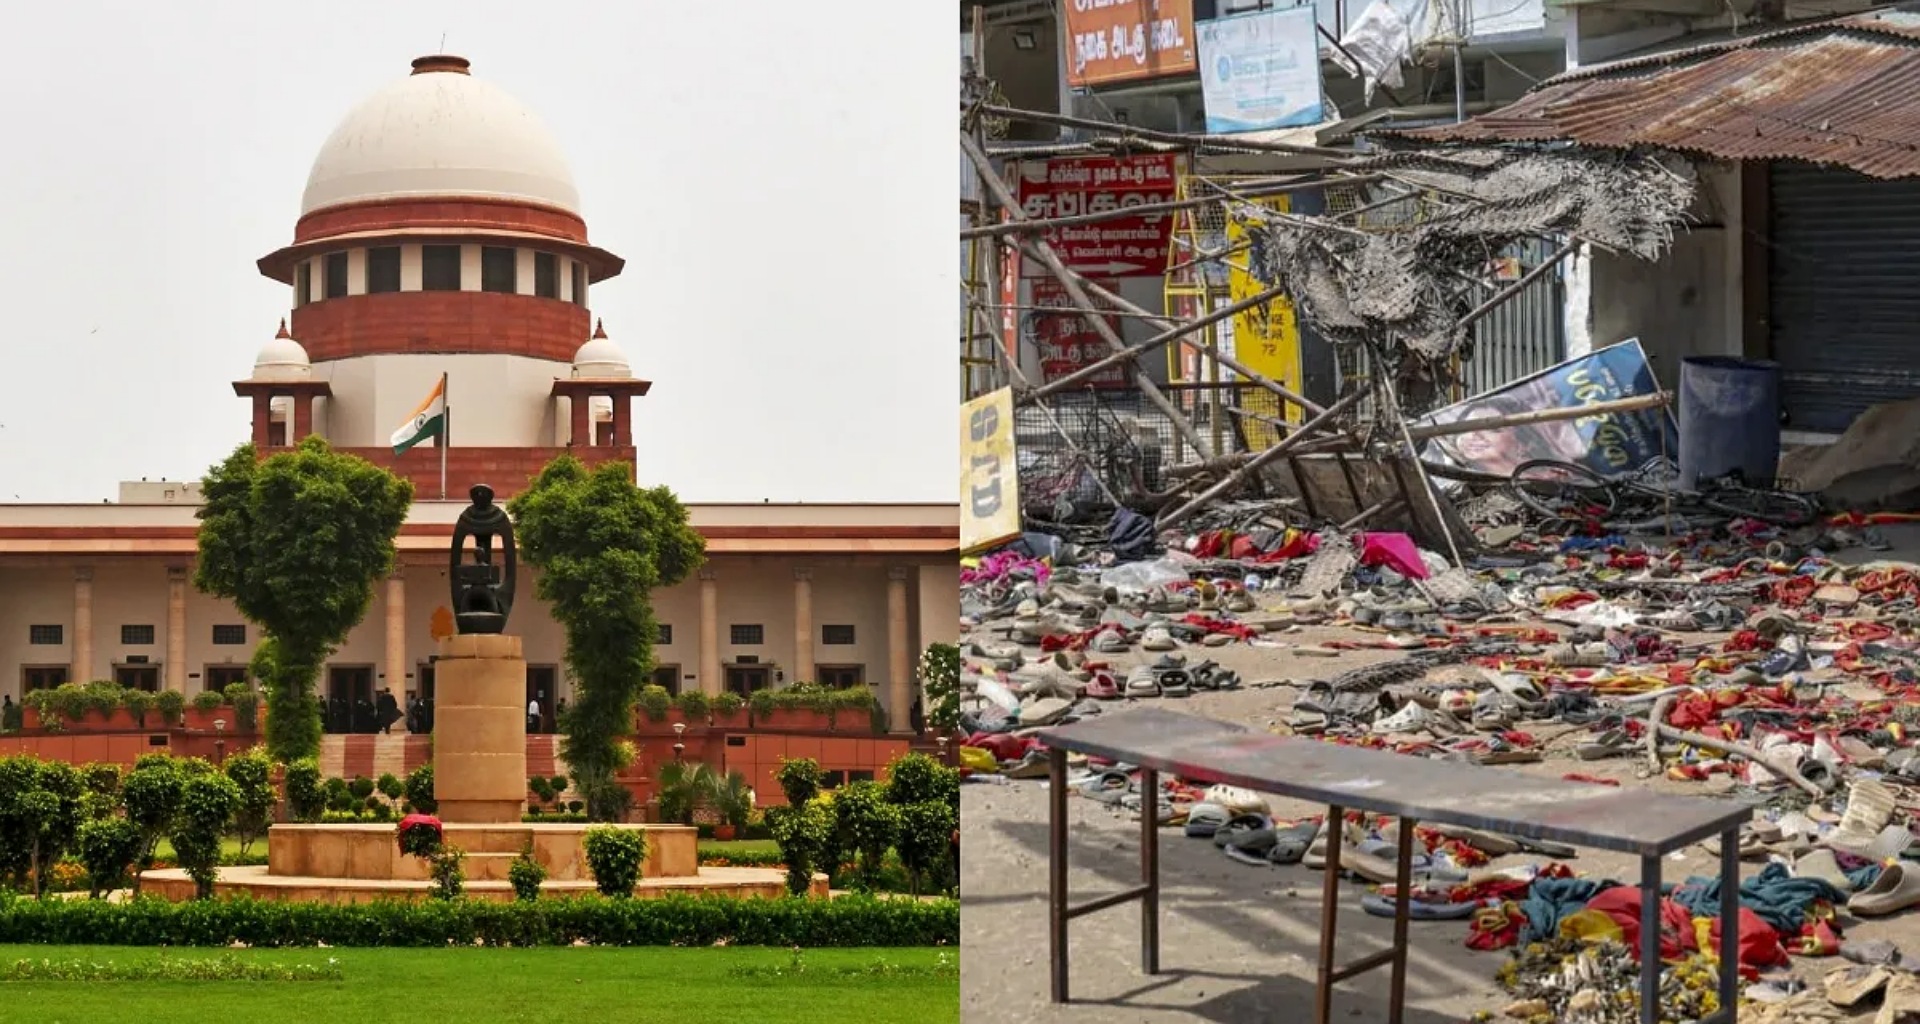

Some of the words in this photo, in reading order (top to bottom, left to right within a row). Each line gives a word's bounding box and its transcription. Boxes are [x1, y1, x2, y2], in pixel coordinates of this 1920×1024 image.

[1075, 30, 1107, 75] நகை
[1112, 23, 1146, 65] அடகு
[1151, 17, 1184, 51] கடை
[1119, 165, 1145, 185] அடகு
[1124, 246, 1157, 259] அடகு
[970, 404, 1003, 519] STD
